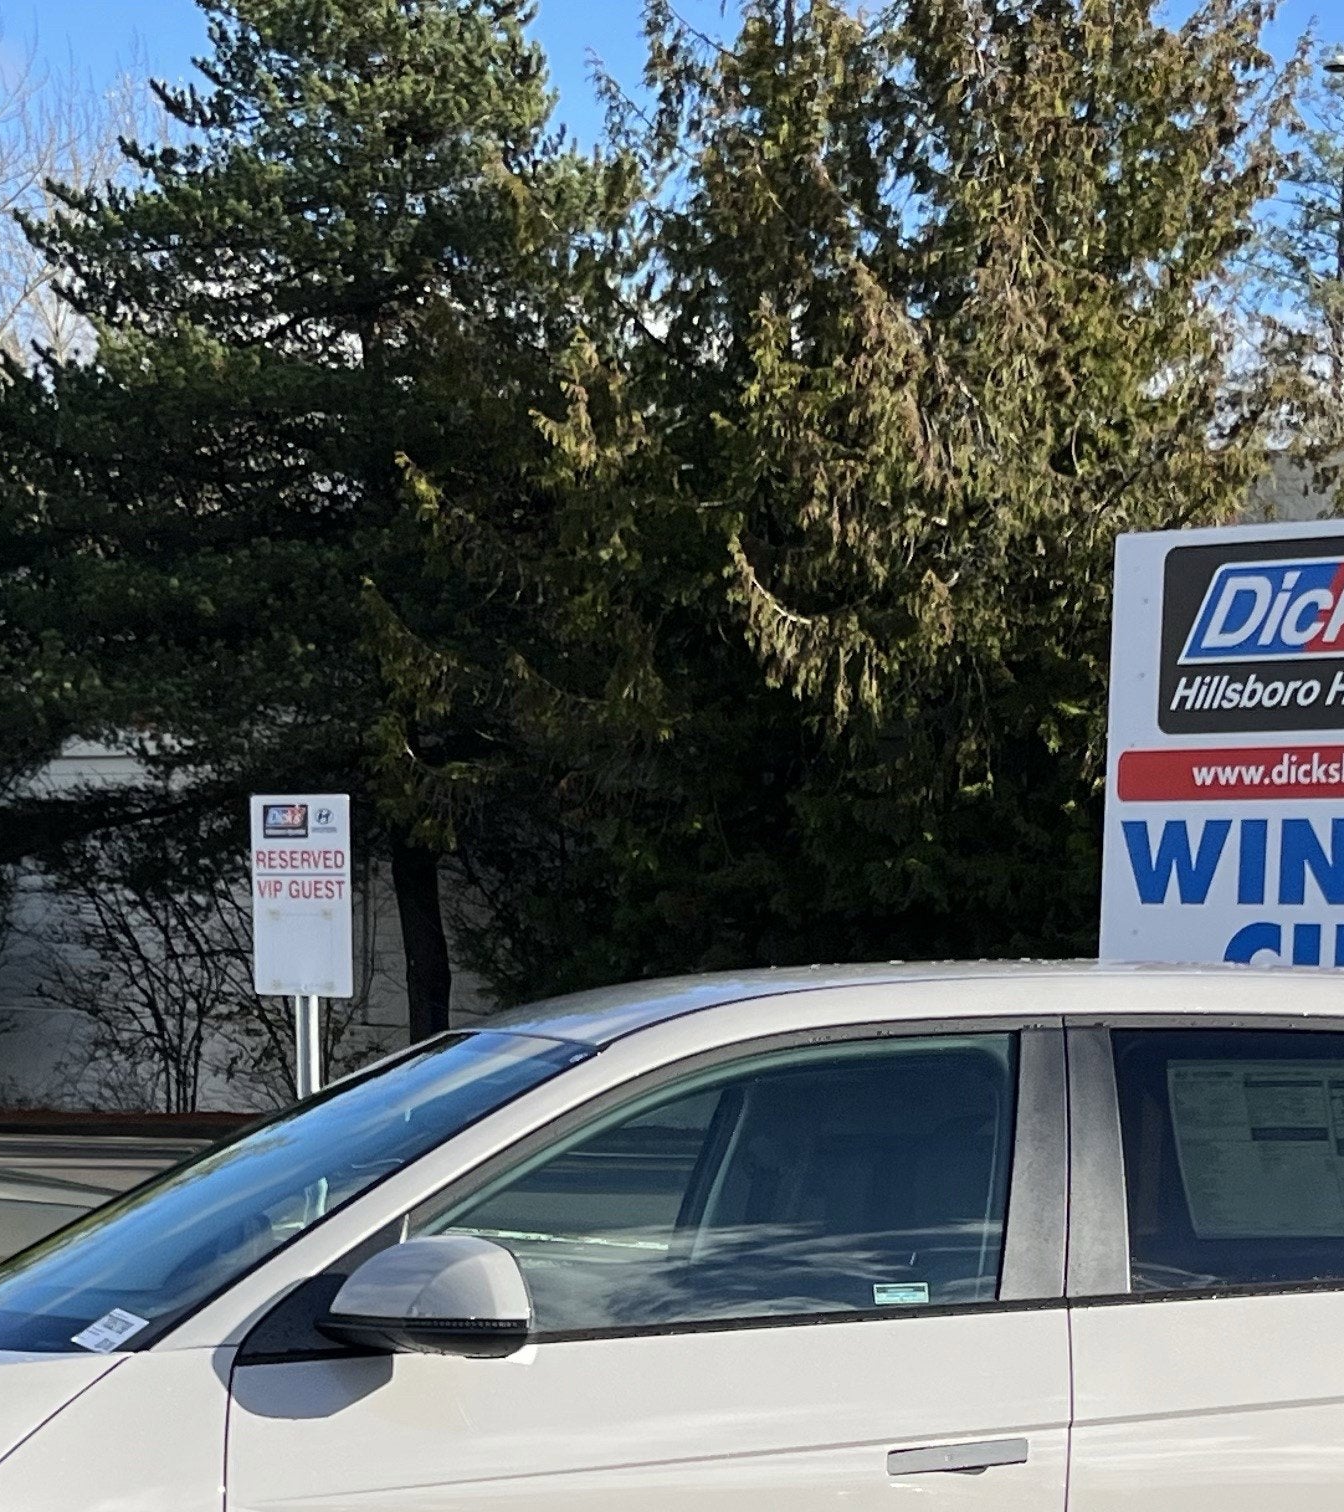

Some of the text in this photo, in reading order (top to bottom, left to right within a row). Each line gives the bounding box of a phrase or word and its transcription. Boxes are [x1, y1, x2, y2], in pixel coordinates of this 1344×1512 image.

[1169, 673, 1322, 712] Hillsboro
[255, 850, 346, 869] RESERVED
[257, 880, 346, 899] VIP GUEST
